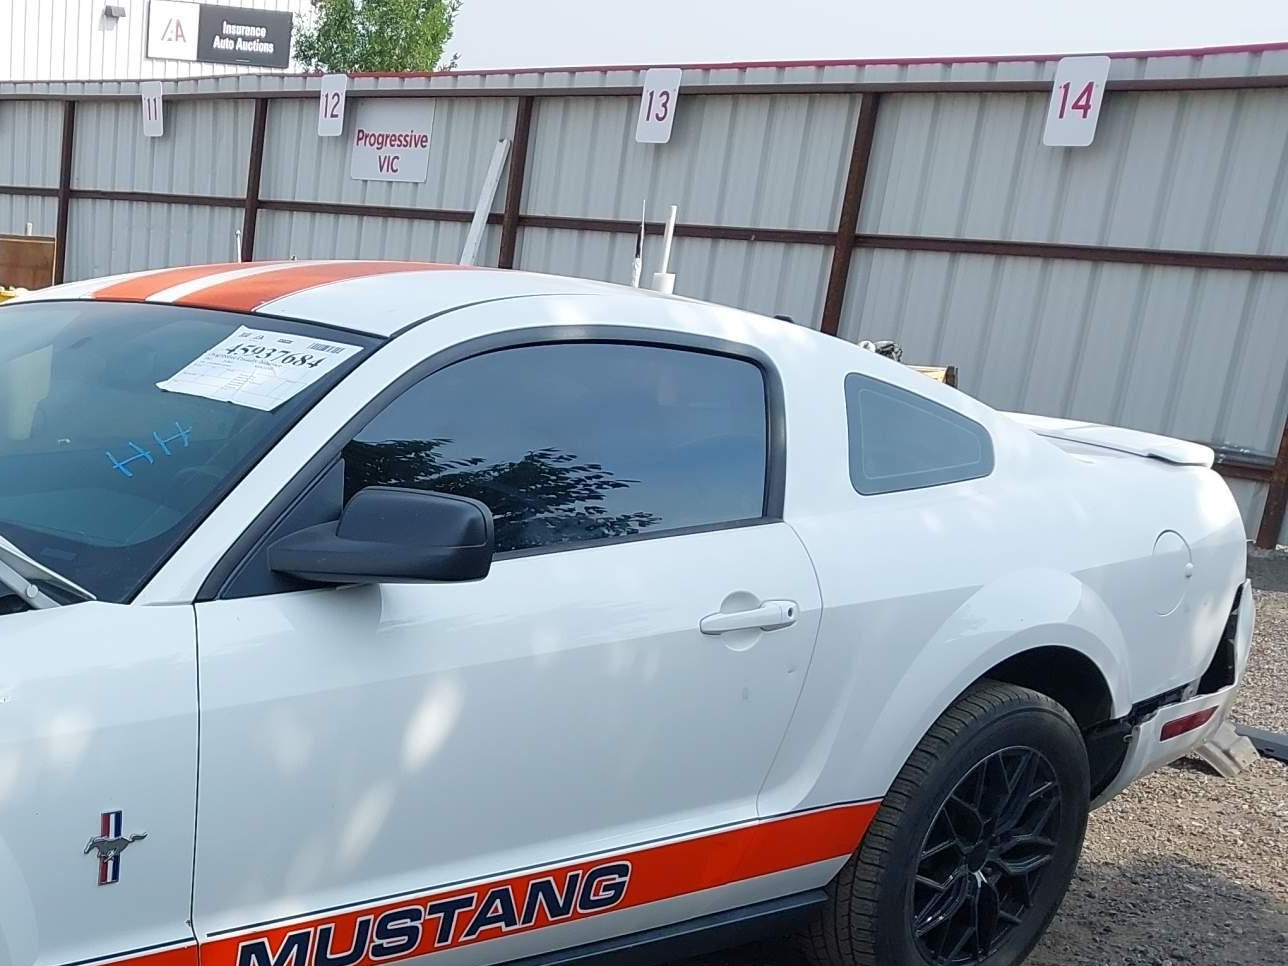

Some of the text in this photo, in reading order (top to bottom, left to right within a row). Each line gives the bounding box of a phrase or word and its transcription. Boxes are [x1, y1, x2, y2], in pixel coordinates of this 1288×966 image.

[222, 21, 266, 37] Insurance
[213, 35, 274, 53] Auto Auctions
[145, 96, 158, 121] 11
[323, 92, 340, 118] 12
[645, 90, 670, 122] 13
[1058, 81, 1095, 119] 14
[355, 129, 429, 149] Progressive
[378, 155, 400, 173] VIC
[225, 342, 326, 369] 45937684
